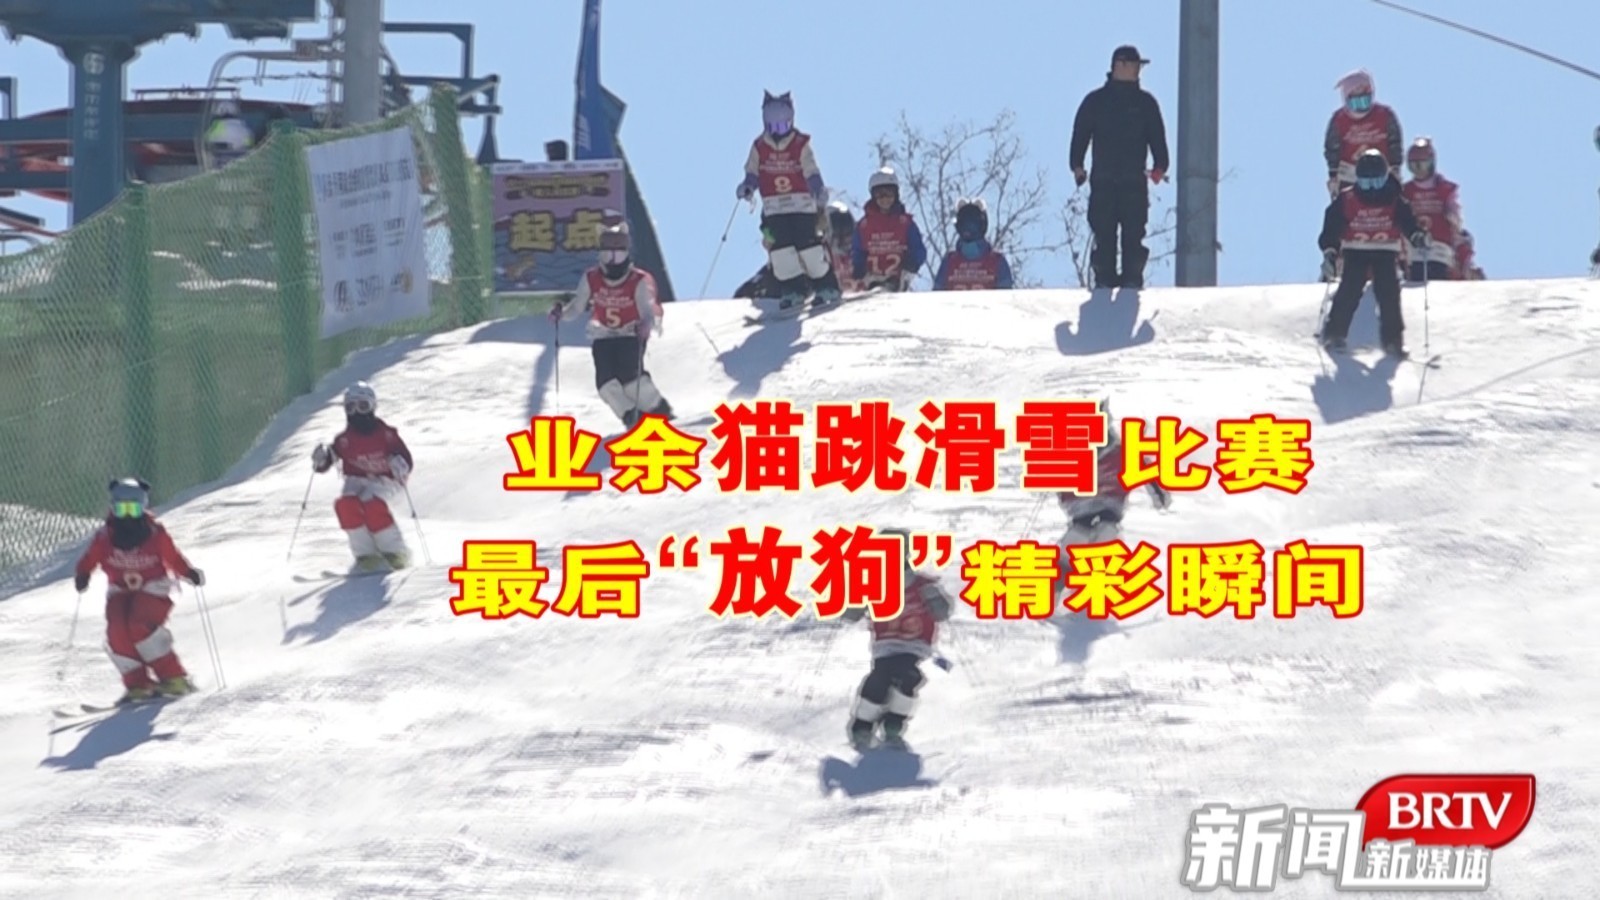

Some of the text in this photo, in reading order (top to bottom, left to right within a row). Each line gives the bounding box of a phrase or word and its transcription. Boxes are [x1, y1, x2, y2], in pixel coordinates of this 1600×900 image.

[510, 209, 602, 252] 起点
[866, 253, 902, 275] 12
[605, 307, 622, 328] 5
